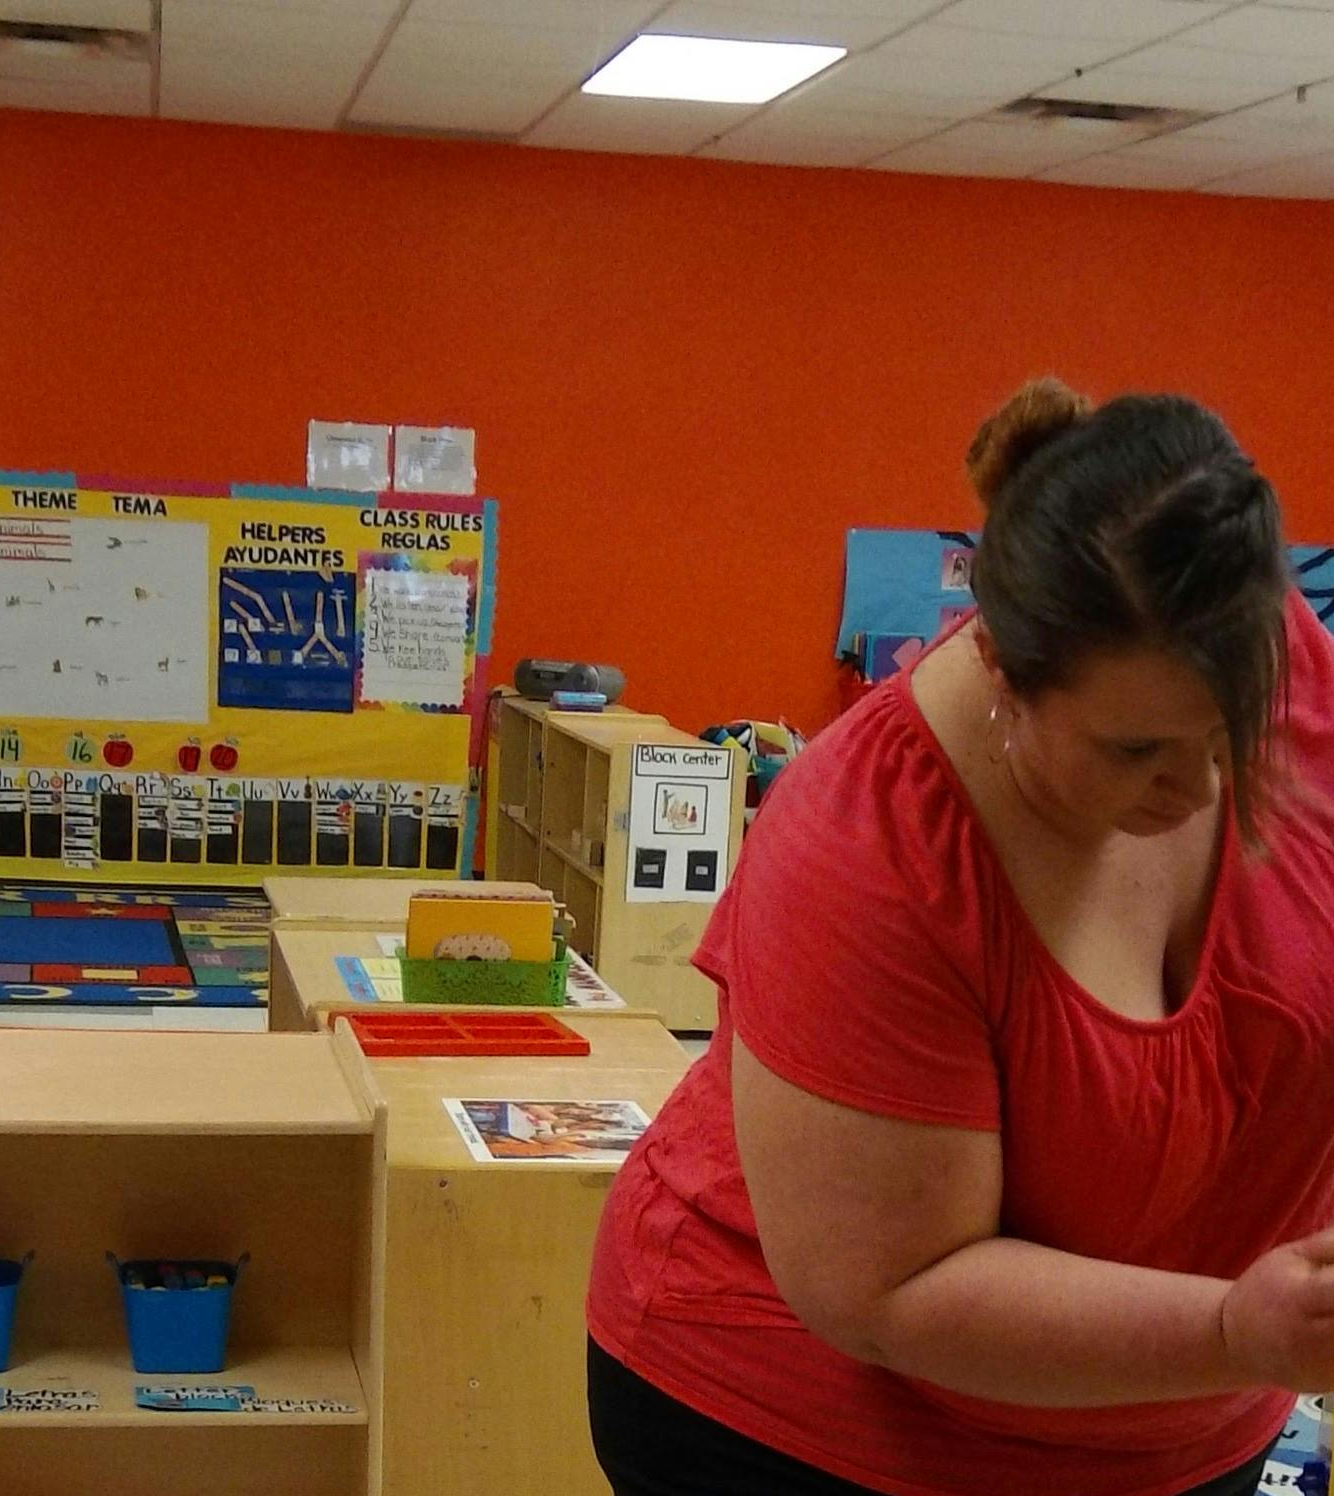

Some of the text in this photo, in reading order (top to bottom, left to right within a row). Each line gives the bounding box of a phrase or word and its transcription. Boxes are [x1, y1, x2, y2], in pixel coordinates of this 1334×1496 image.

[12, 490, 167, 516] THEME TEMA
[360, 510, 483, 532] CLASS RULES
[240, 522, 326, 544] HELPERS
[381, 532, 450, 551] REGLAS
[224, 546, 344, 567] AYUDANTES
[0, 738, 19, 762] 14
[71, 741, 92, 763] 16
[640, 747, 722, 767] Block Center
[27, 770, 49, 789] Oo
[64, 772, 83, 791] Pp
[99, 773, 123, 793] Qq
[136, 776, 156, 794] Rr
[170, 778, 191, 796] Ss
[206, 778, 223, 798] Tt
[278, 781, 299, 799] Vv
[390, 784, 407, 804] Yy
[429, 787, 451, 805] Zz
